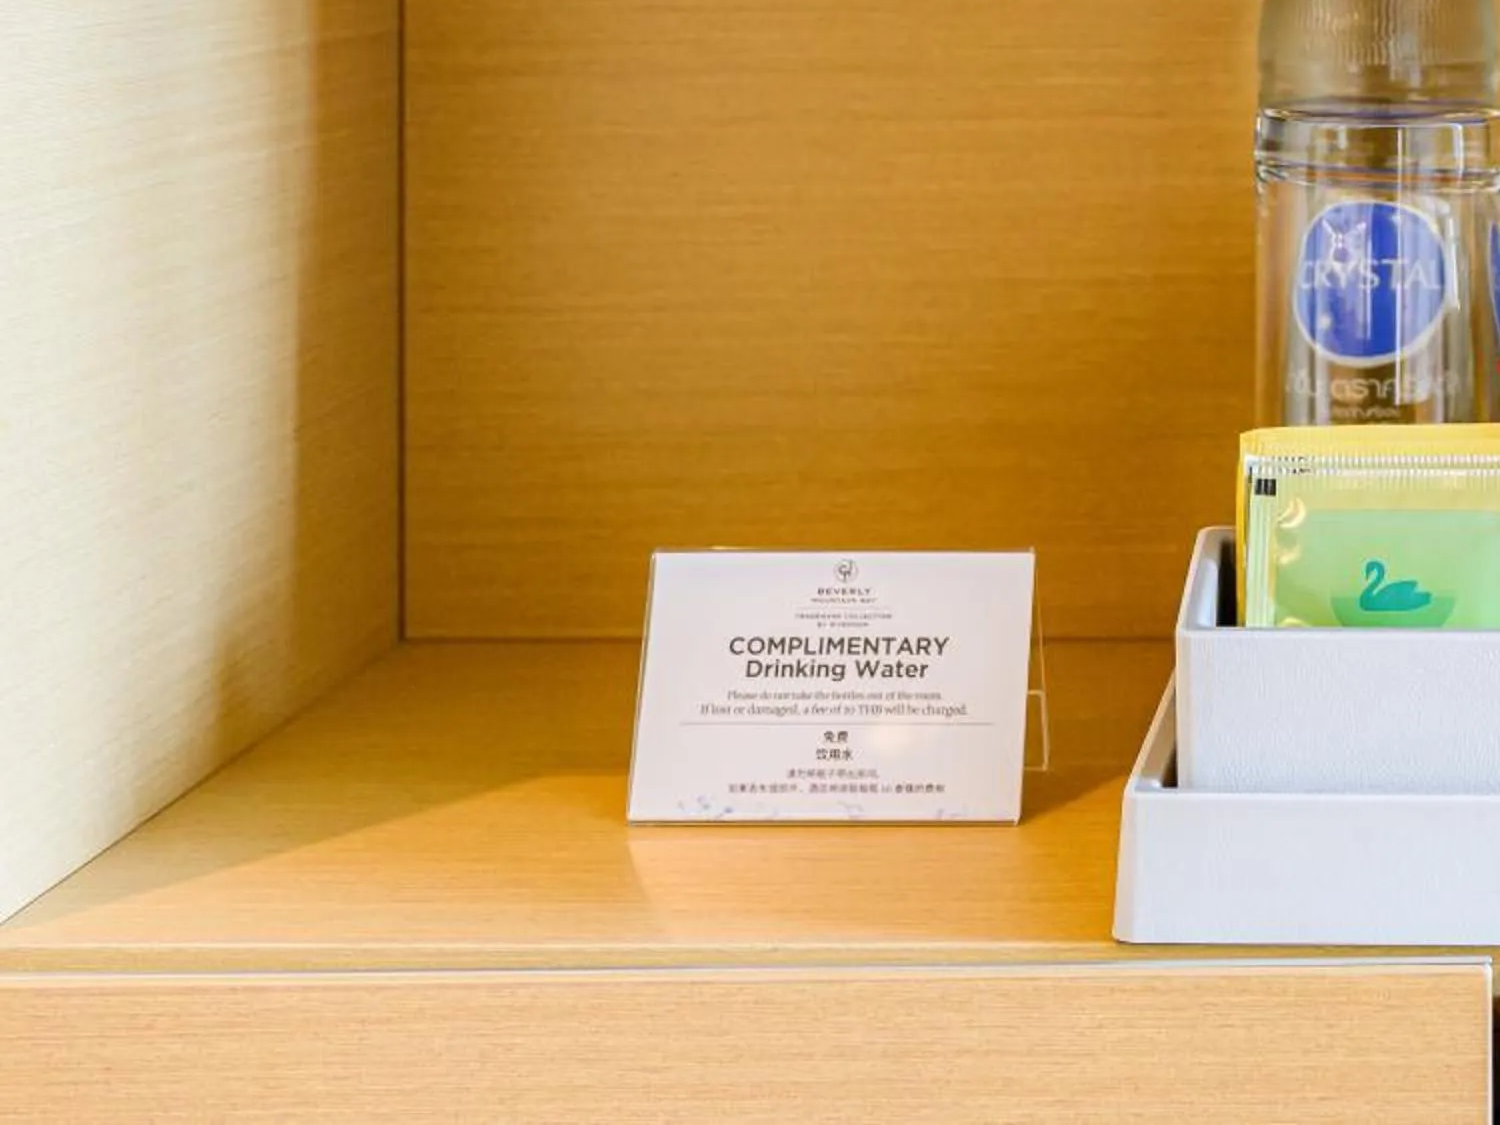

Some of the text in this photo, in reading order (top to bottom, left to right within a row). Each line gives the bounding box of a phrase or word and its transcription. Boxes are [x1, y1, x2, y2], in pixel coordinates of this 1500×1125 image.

[729, 636, 950, 656] COMPLIMENTARY
[745, 659, 930, 682] Drinking Water
[823, 730, 850, 744] 免费
[815, 747, 854, 762] 饮用水
